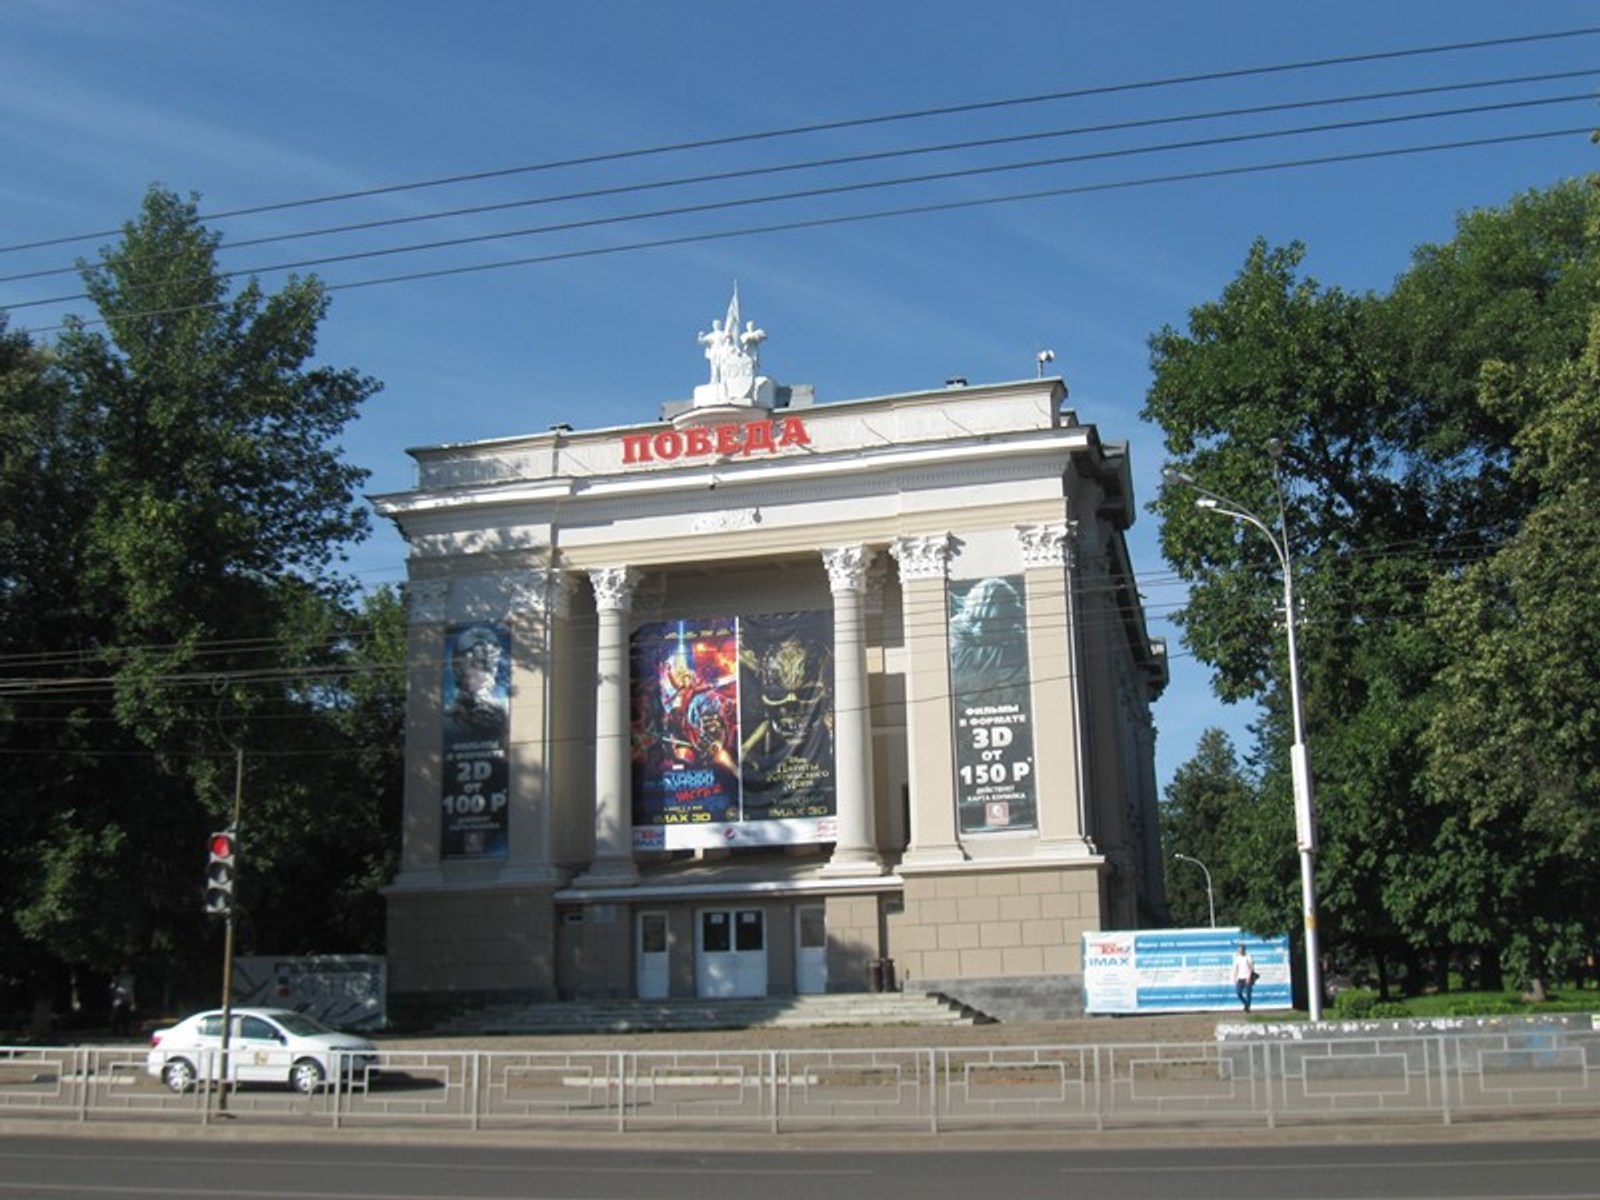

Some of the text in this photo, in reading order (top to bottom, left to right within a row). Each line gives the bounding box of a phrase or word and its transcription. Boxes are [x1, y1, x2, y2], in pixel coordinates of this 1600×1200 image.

[622, 415, 811, 464] ПОБЕДА
[966, 705, 1019, 716] ФИЛЬМЫ
[969, 714, 1026, 726] ФОРМАТЕ
[971, 726, 1013, 749] 3D
[981, 750, 1003, 761] ОТ
[456, 760, 492, 781] 2D
[959, 763, 1006, 785] 150
[463, 782, 483, 793] ОТ
[442, 794, 486, 815] 100
[1088, 956, 1129, 967] IMAX
